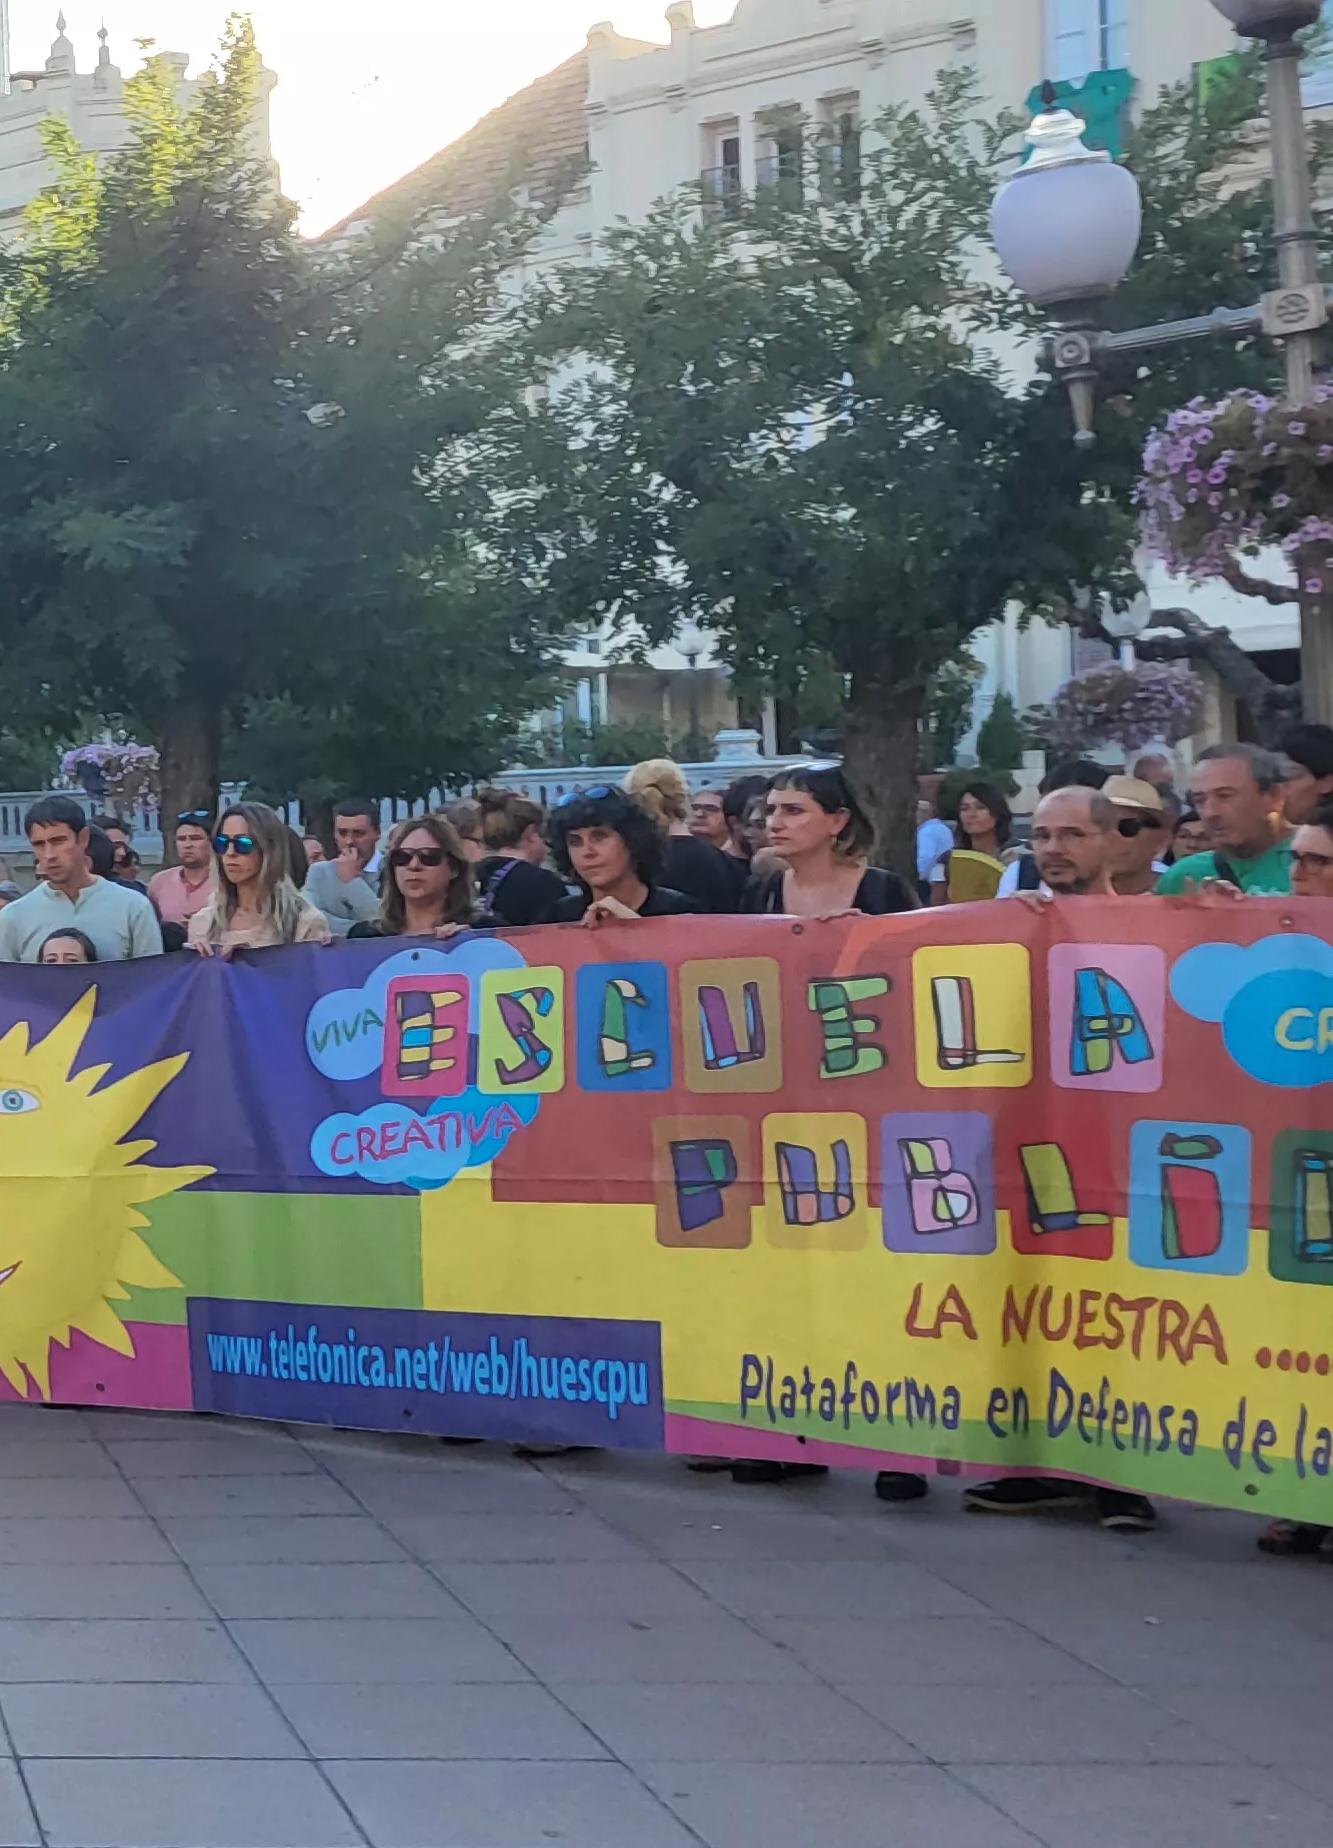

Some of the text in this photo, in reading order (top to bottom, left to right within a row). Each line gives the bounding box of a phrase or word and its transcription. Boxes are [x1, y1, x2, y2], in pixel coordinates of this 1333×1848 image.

[312, 1008, 384, 1053] VIVA
[395, 966, 1155, 1086] ESCUELA
[329, 1101, 528, 1165] CREATIVA
[904, 1281, 979, 1340] LA
[1001, 1283, 1230, 1366] NUESTRA
[205, 1323, 650, 1420] www.telefonica.net/web/huescpu
[739, 1353, 1333, 1480] Plataforma en Defensa de la
